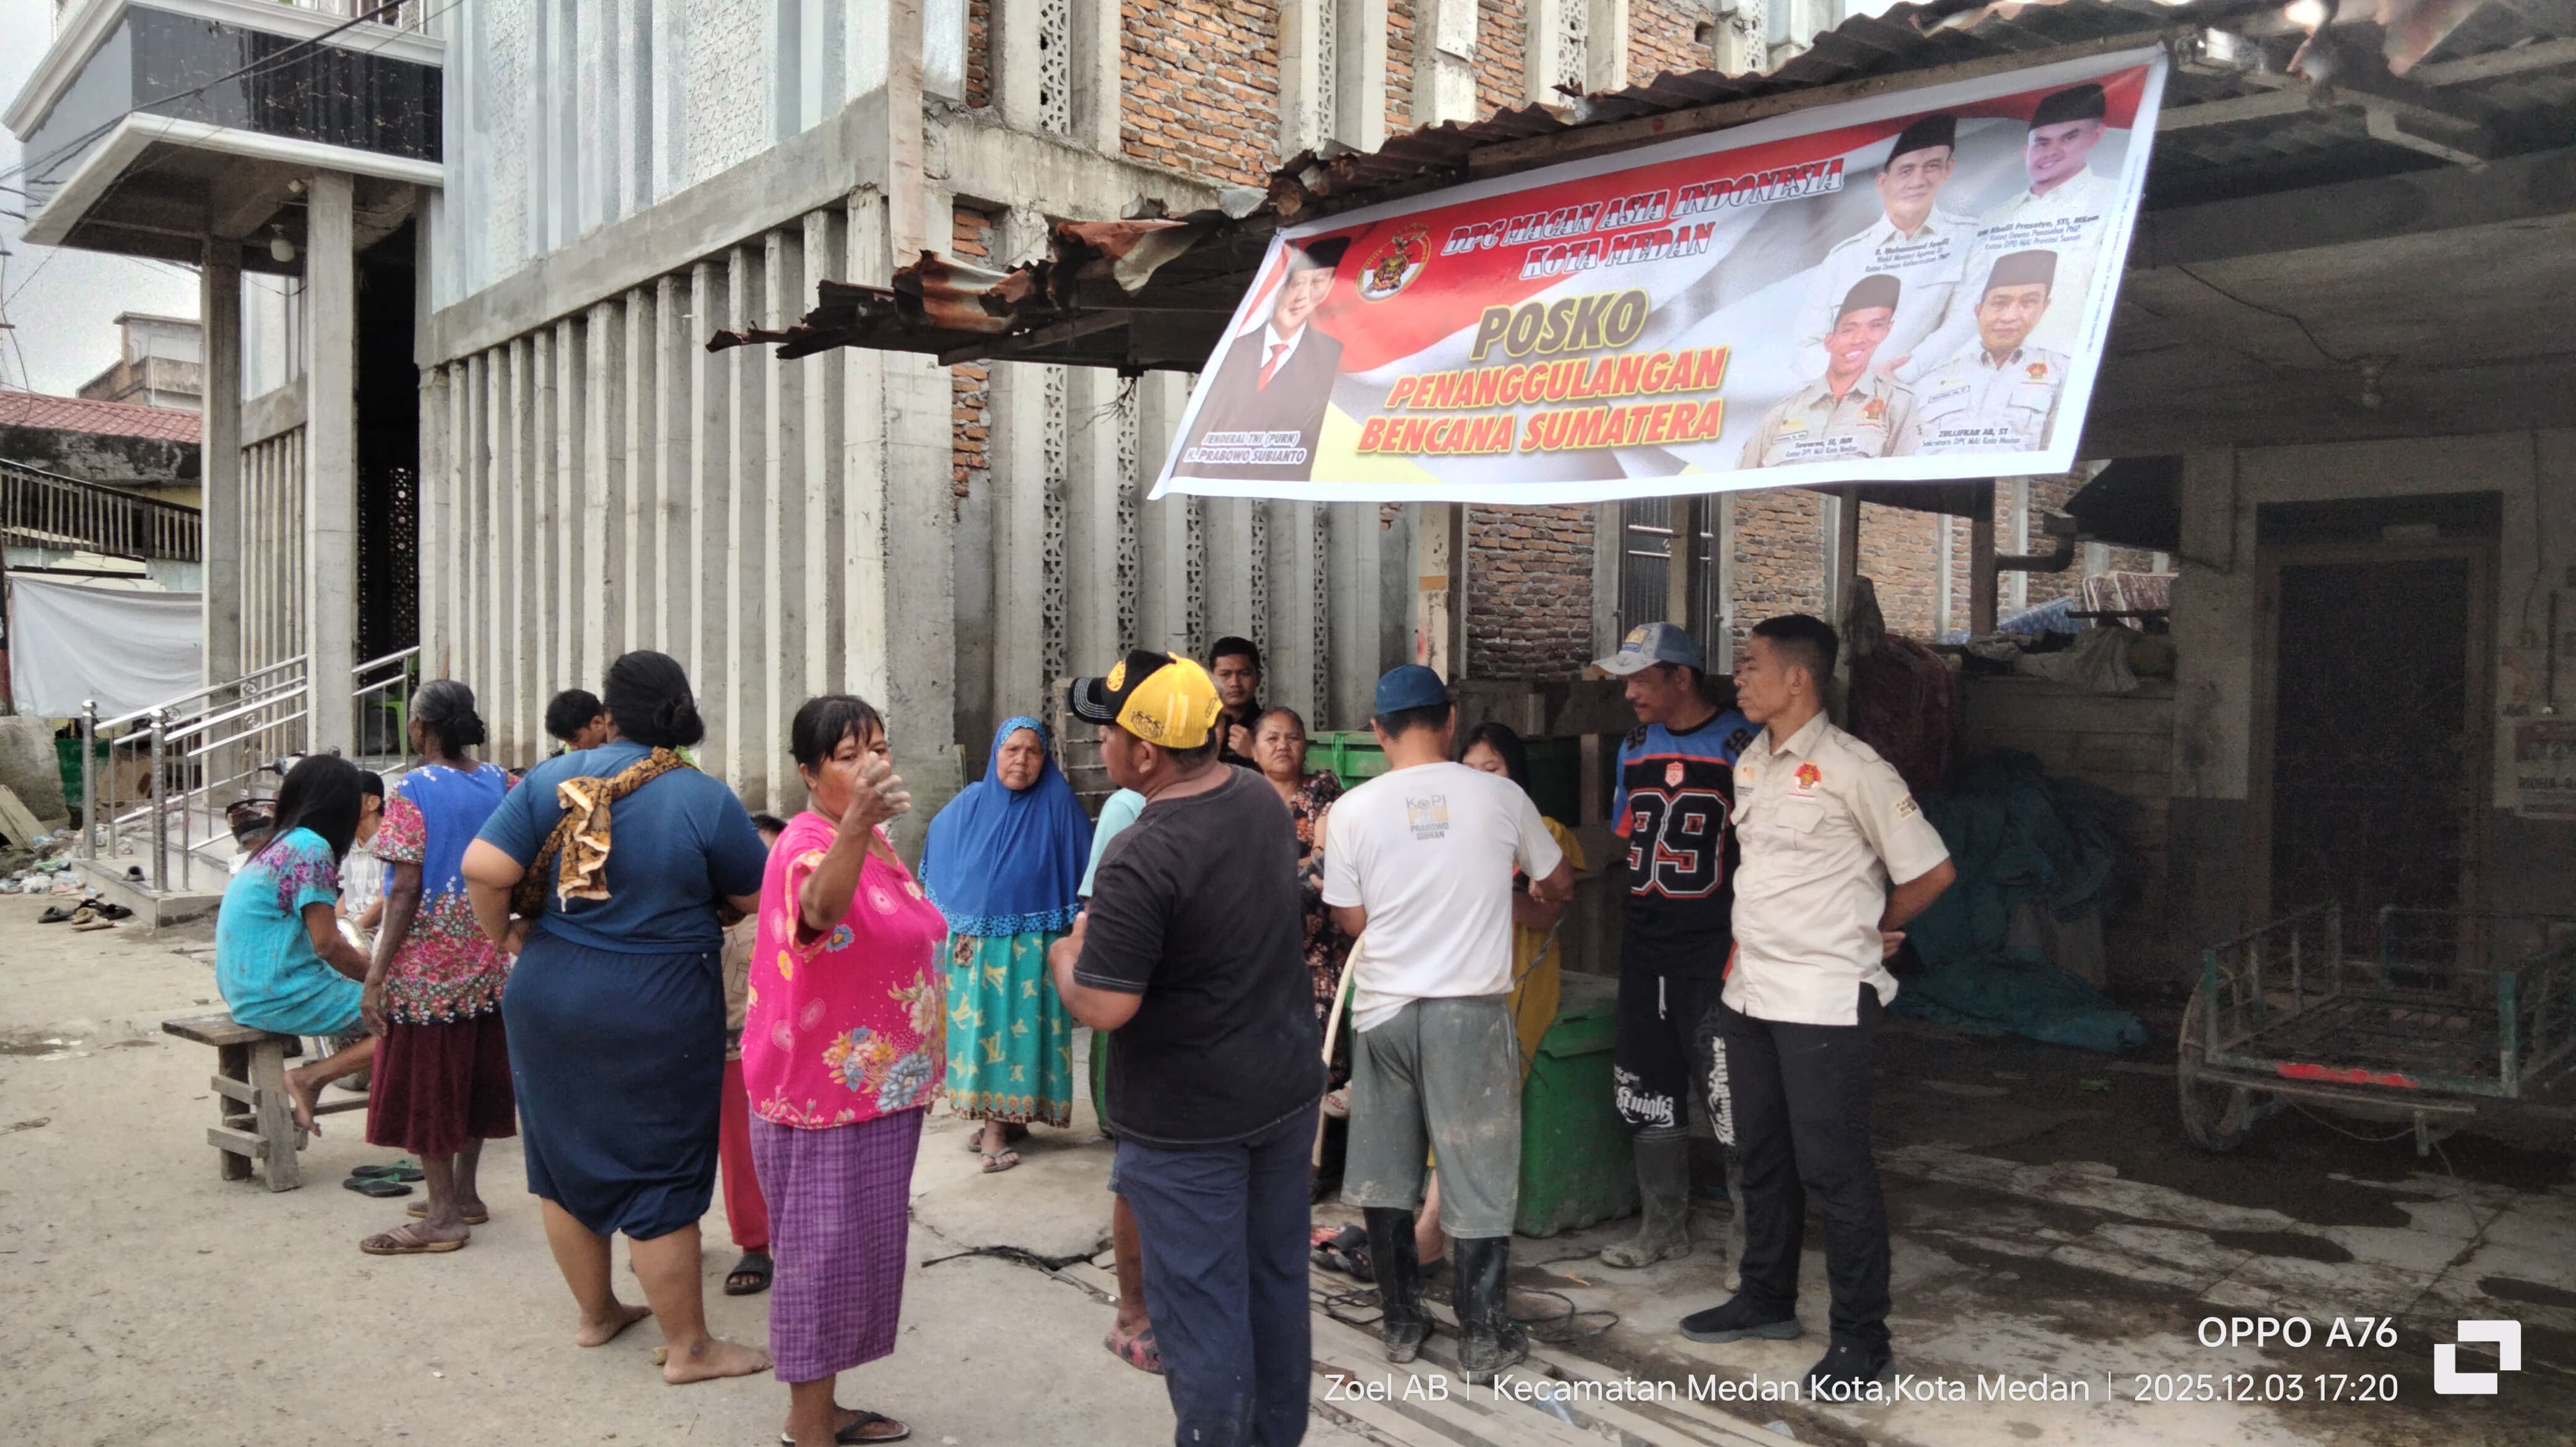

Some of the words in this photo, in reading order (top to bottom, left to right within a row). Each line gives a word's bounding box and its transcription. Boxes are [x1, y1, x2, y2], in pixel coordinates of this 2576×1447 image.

[1441, 219, 1505, 256] DPC
[1500, 201, 1603, 246] MACAN
[1596, 189, 1669, 230] ASIA
[1669, 157, 1845, 218] INDONESIA
[1518, 238, 1603, 280] KOTA
[1605, 220, 1717, 268] MEDAN
[1469, 288, 1650, 361] POSKO
[1384, 345, 1729, 409] PENANGGULANGAN
[1204, 433, 1245, 445] JENDERAL
[1248, 433, 1263, 445] TNI
[1264, 432, 1300, 447] (PURN)
[1356, 413, 1517, 455] BENCANA
[1518, 398, 1725, 453] SUMATERA
[1198, 450, 1250, 462] PRABOWO
[1251, 450, 1305, 463] SUBIANTO
[1410, 823, 1449, 833] PRABOWO
[1416, 831, 1445, 841] GIBRAN
[1624, 789, 1731, 898] 99
